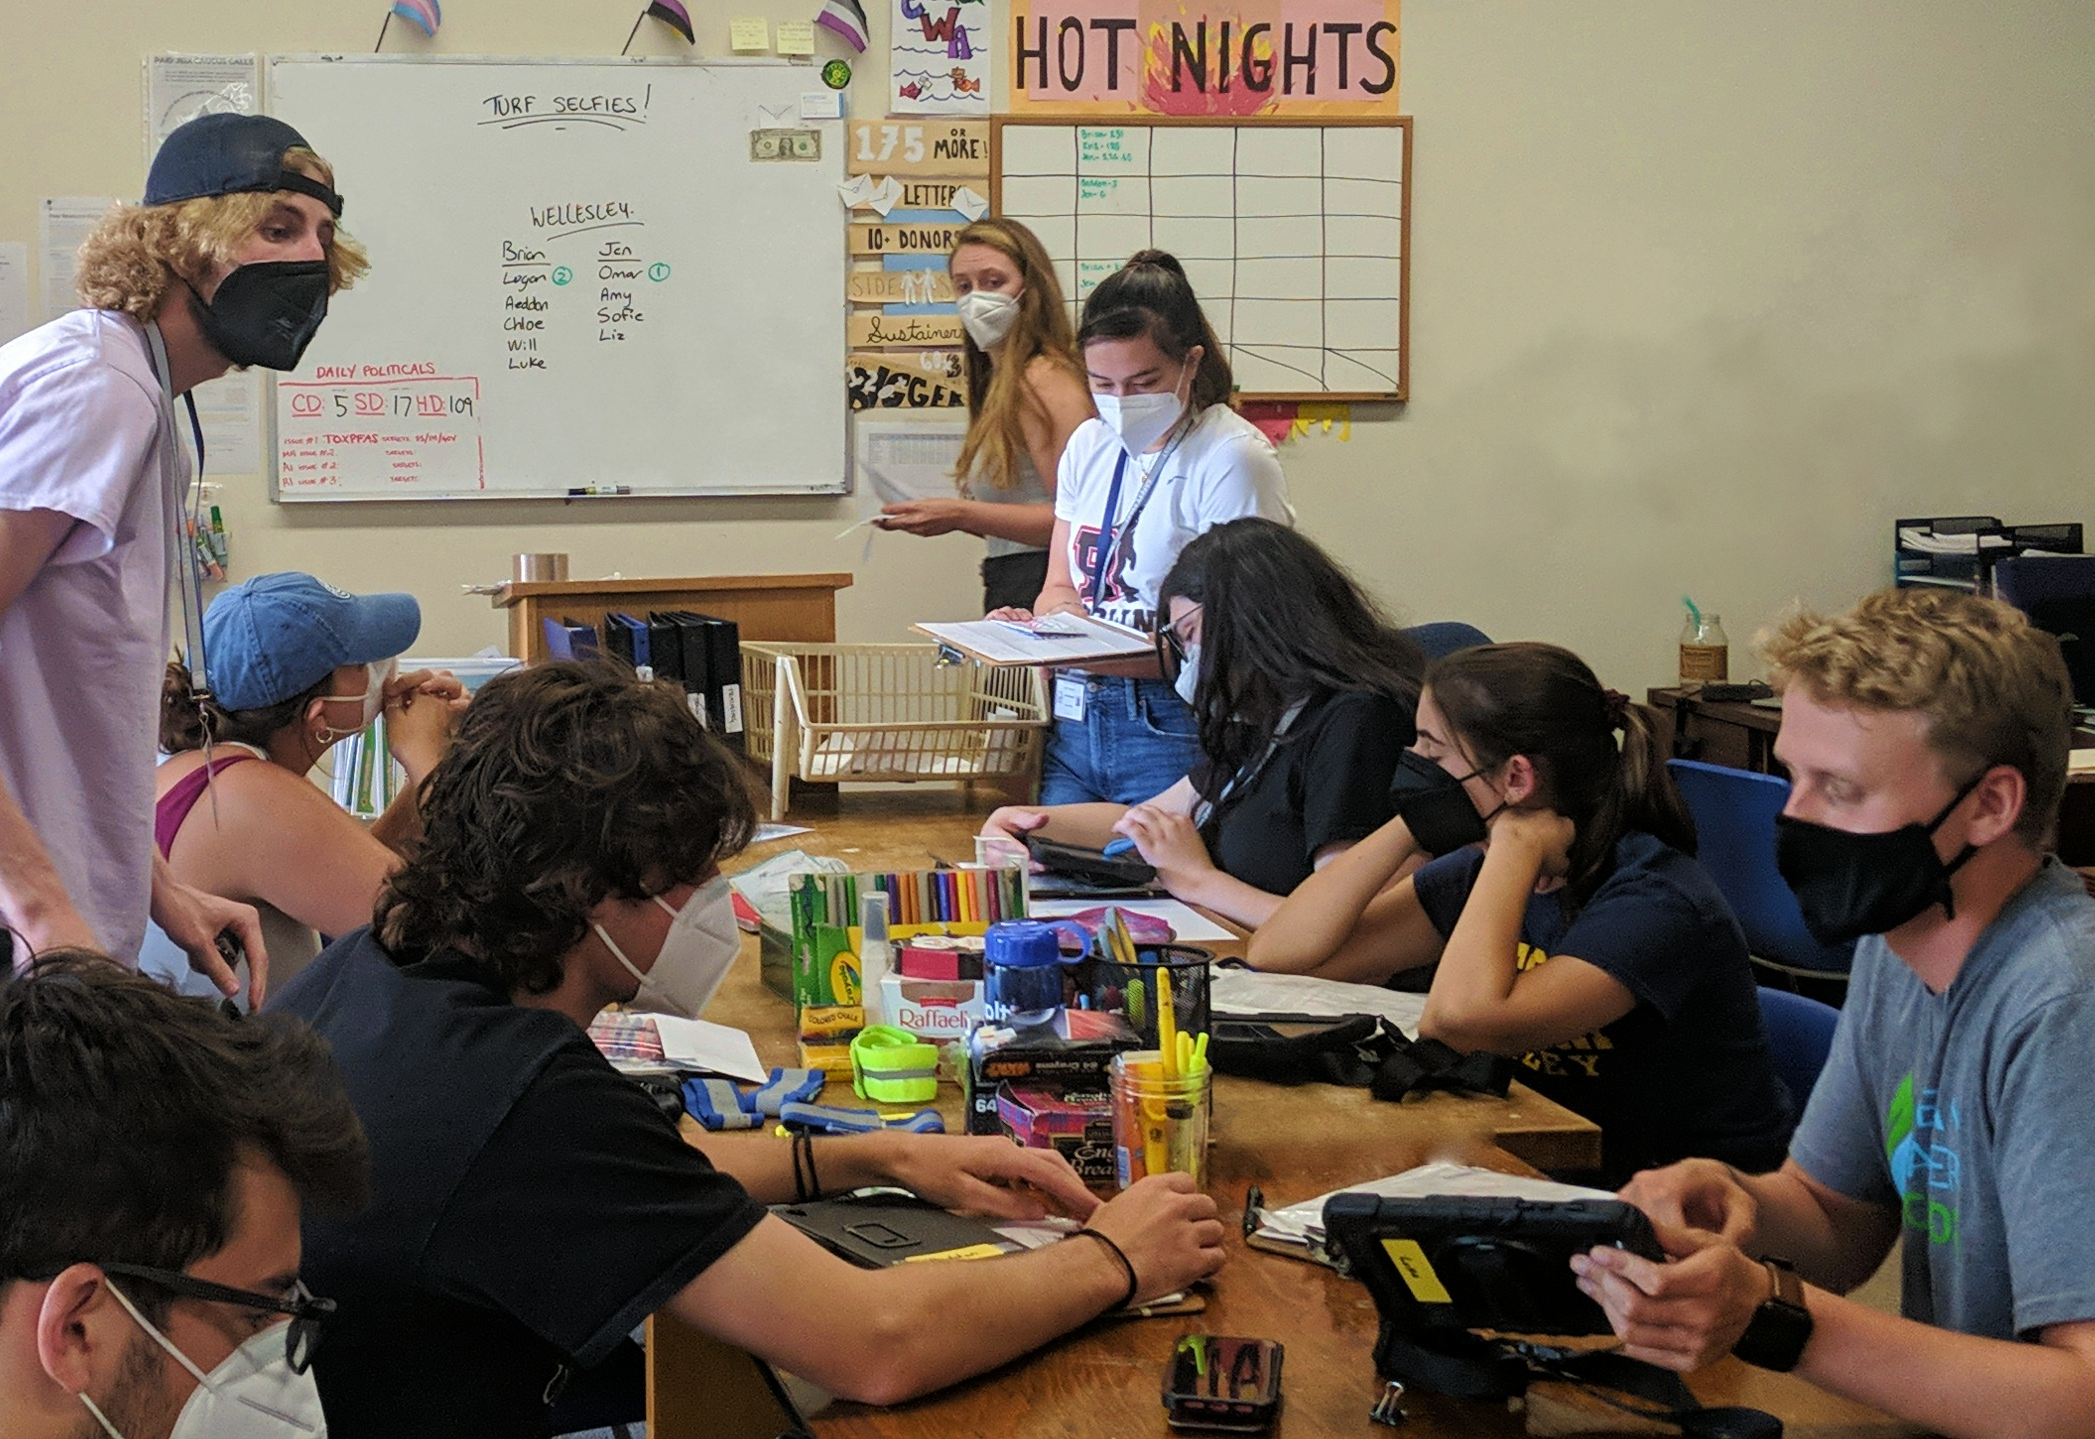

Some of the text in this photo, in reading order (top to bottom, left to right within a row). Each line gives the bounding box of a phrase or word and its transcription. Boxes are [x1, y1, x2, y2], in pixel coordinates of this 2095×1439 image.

[1016, 16, 1398, 95] HOT NIGHTS
[483, 83, 651, 118] TURF SELFIES!
[950, 128, 966, 137] OR
[855, 125, 925, 163] 175
[502, 240, 546, 261] Brian
[599, 241, 632, 256] Jen
[599, 265, 643, 280] Omar
[503, 272, 546, 292] Logan
[600, 287, 632, 308] Amy
[503, 317, 545, 331] Chloe
[599, 329, 626, 341] Liz
[508, 338, 537, 351] Will
[508, 357, 547, 370] Luke
[317, 364, 356, 379] DAILY
[334, 395, 349, 417] 5
[394, 396, 413, 417] 17
[450, 395, 473, 417] 109
[975, 1098, 998, 1113] 64
